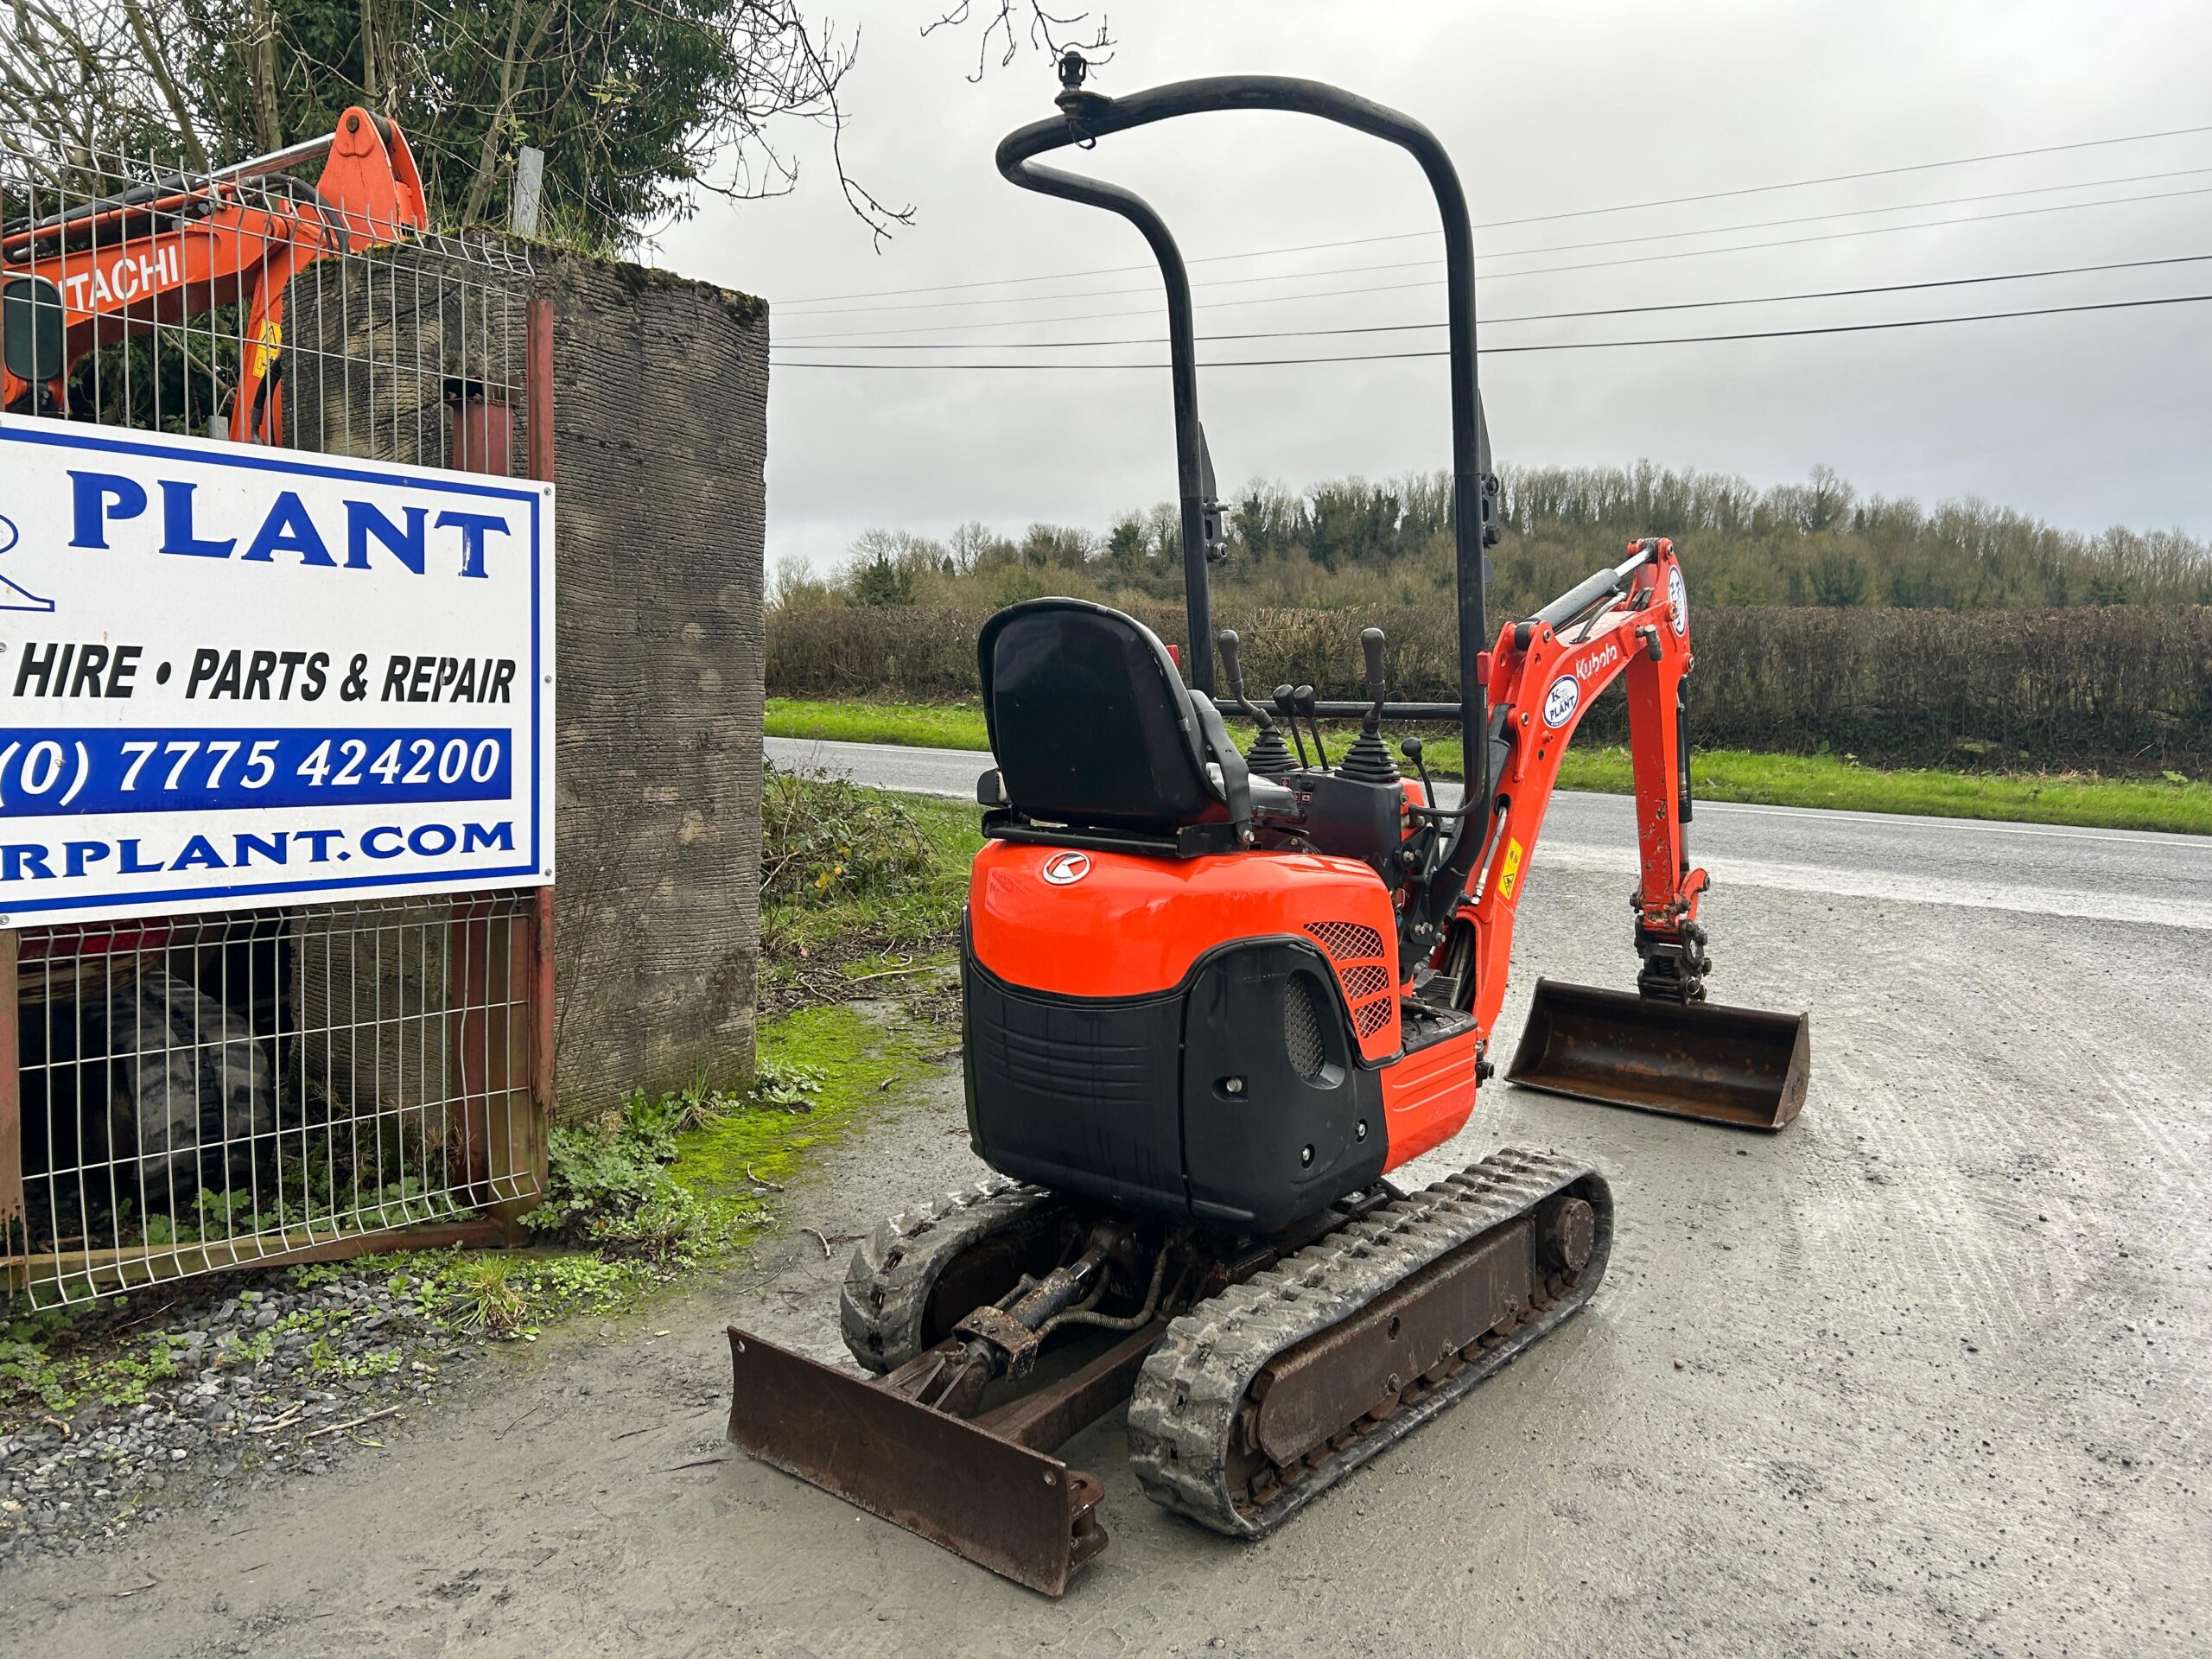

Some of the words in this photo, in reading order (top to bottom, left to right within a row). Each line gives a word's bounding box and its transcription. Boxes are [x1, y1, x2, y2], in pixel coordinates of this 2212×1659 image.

[67, 470, 512, 578] PLANT
[13, 642, 143, 698] HIRE
[185, 648, 330, 702] PARTS
[340, 653, 368, 702] &
[380, 655, 517, 703] REPAIR
[1575, 643, 1618, 681] Kubota
[1550, 695, 1574, 721] PLANT
[119, 740, 280, 791] 7775
[296, 738, 500, 787] 424200
[0, 821, 517, 881] RPLANT.COM
